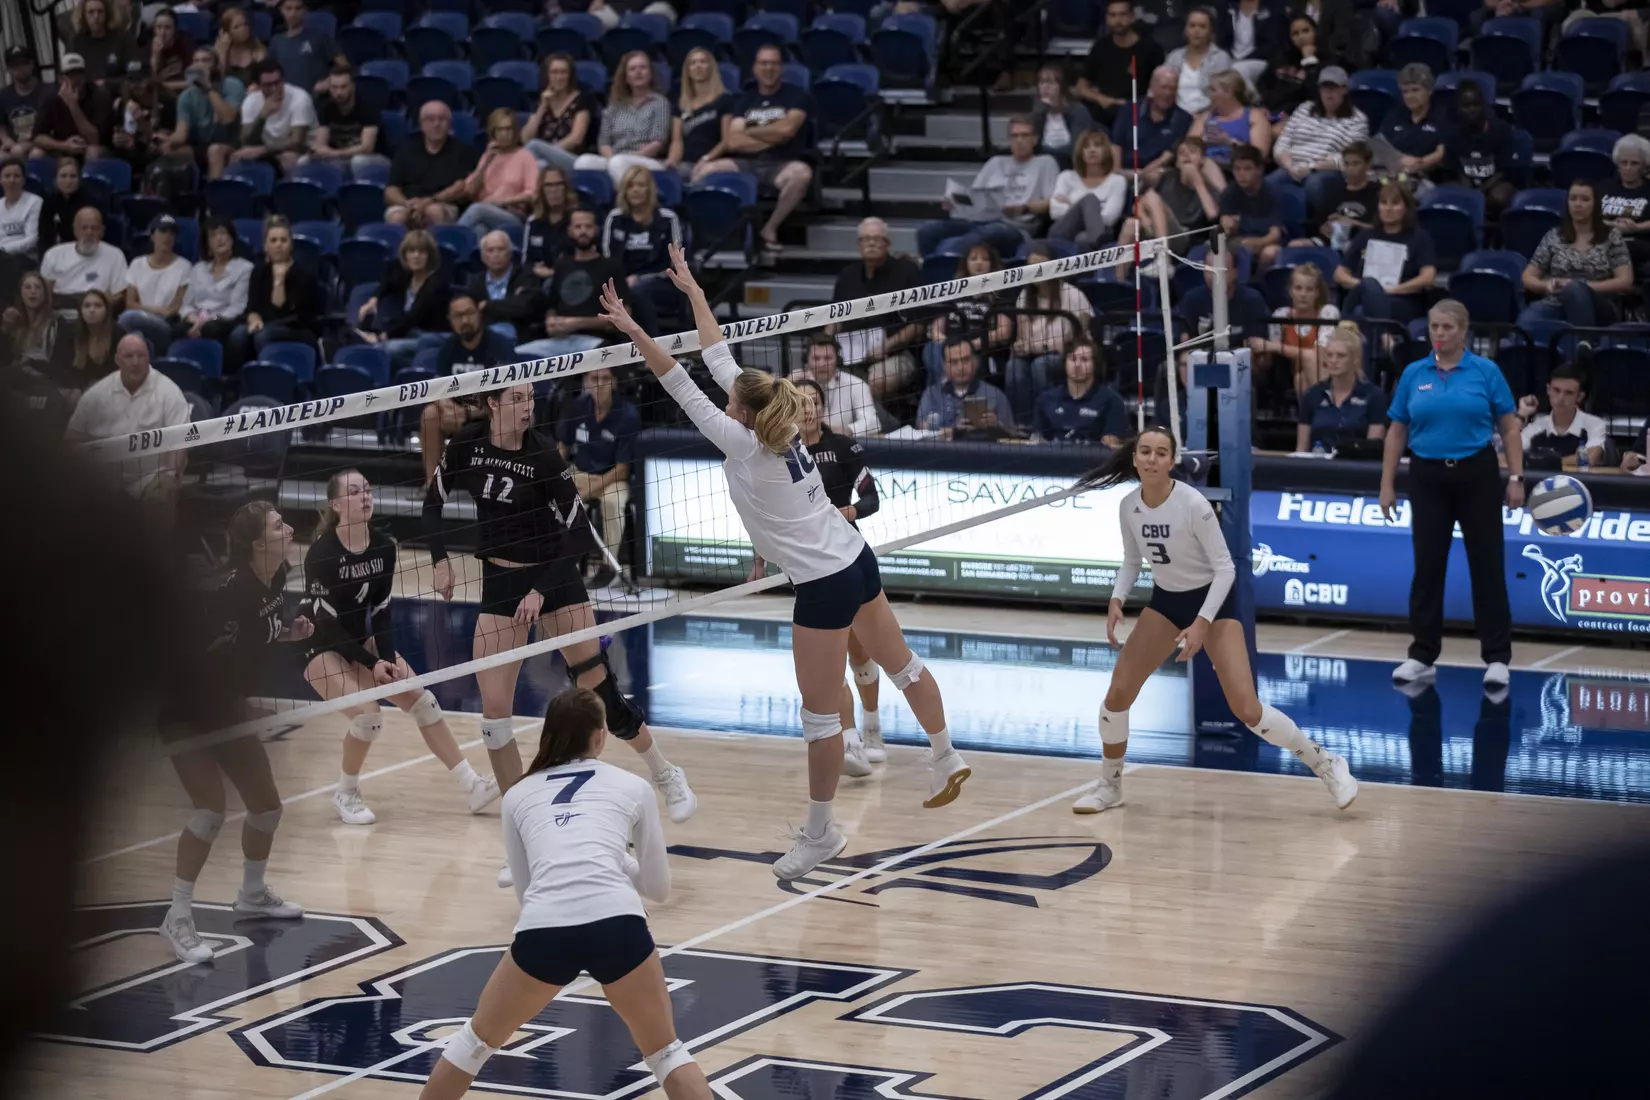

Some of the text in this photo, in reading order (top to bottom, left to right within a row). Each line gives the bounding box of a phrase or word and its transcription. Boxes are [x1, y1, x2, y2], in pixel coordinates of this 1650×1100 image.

[129, 430, 163, 452] CBU
[223, 397, 345, 435] #LANCEUP
[399, 381, 429, 402] CBU
[479, 352, 584, 387] #LANCEUP
[722, 314, 790, 340] ANCEUP
[829, 302, 852, 318] CBU
[889, 279, 969, 308] #LANCEUP
[1003, 268, 1023, 284] CBU
[1055, 247, 1125, 274] #LANCEUP
[513, 463, 535, 478] STATE
[481, 473, 515, 504] 12
[873, 477, 917, 501] AM
[1277, 491, 1413, 528] Fueled
[1141, 524, 1171, 539] CBU
[1146, 542, 1172, 565] 3
[1304, 582, 1349, 605] CBU
[1577, 620, 1623, 632] contract
[546, 769, 596, 806] 7
